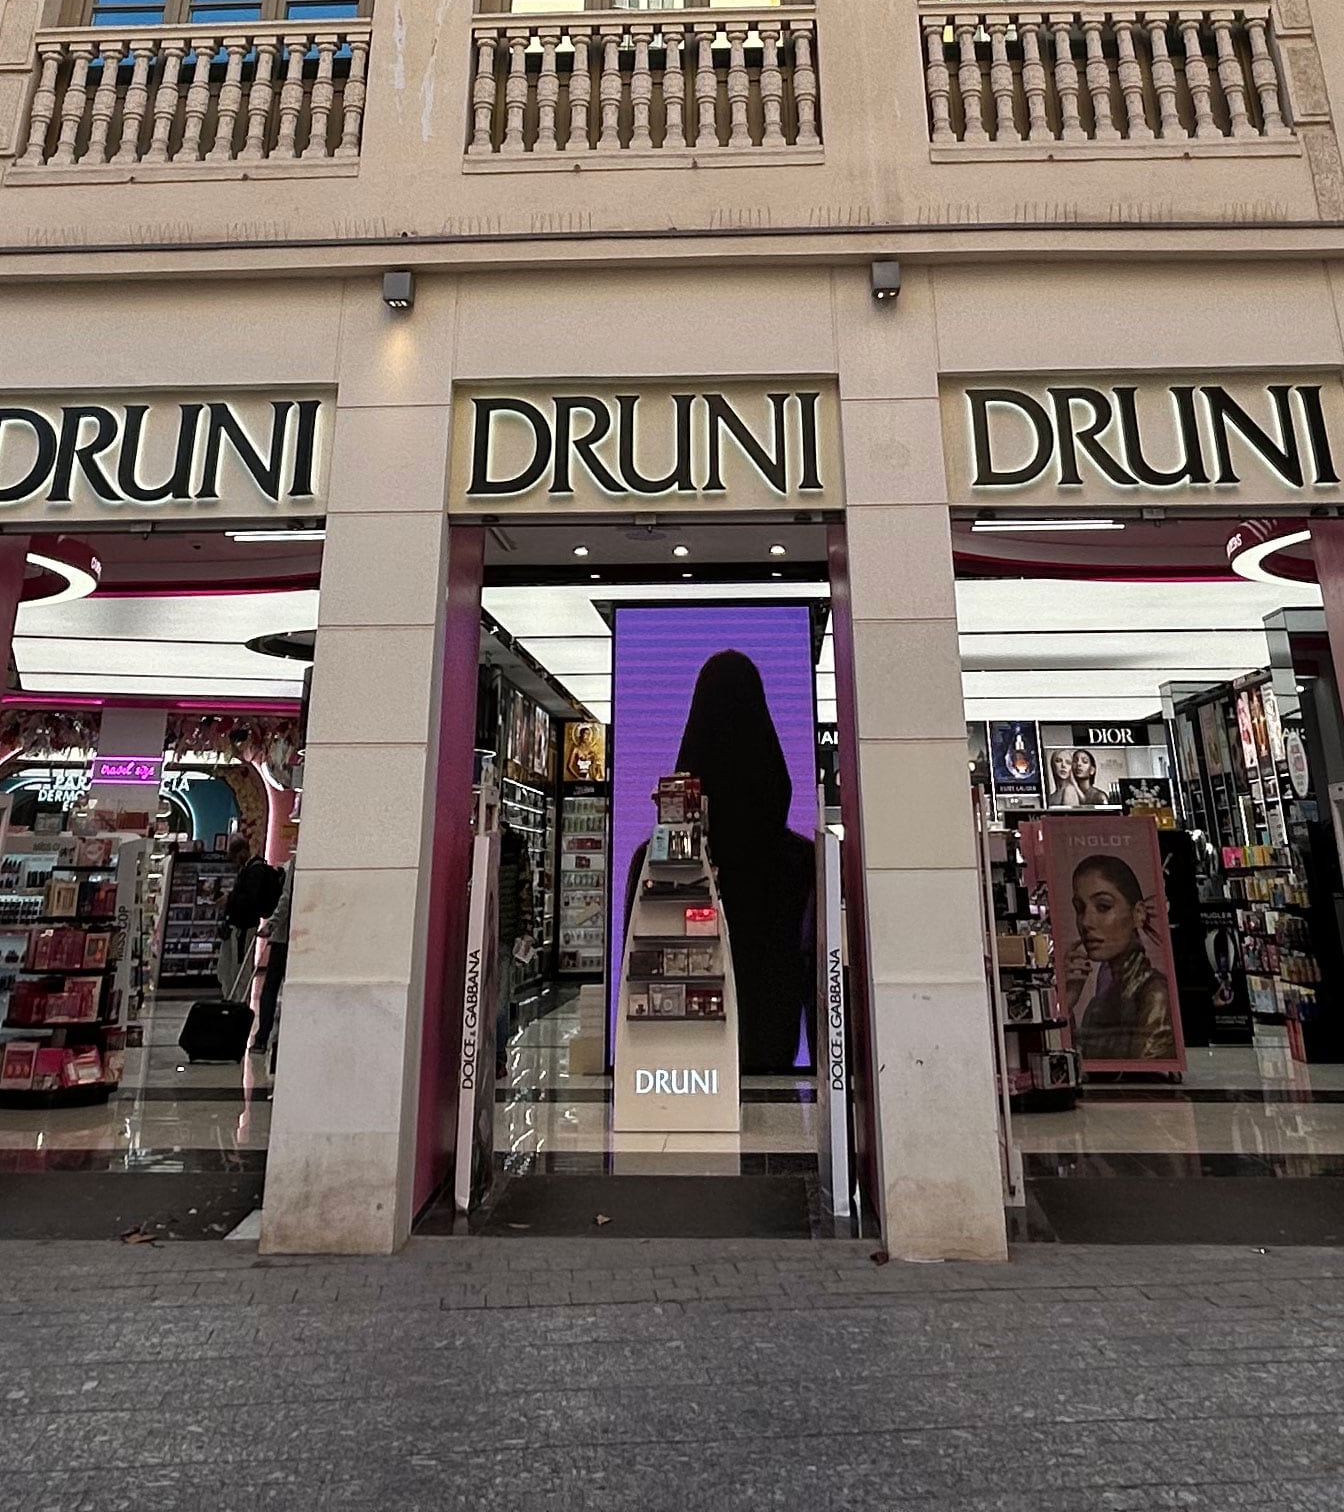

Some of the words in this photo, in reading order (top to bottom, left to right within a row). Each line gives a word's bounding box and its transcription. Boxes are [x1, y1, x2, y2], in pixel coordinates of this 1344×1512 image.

[466, 391, 824, 495] DRUNI
[965, 384, 1342, 488] DRUNI
[1088, 727, 1135, 744] DIOR
[1068, 834, 1131, 848] INGLOT
[465, 948, 481, 1030] GABBANA
[829, 948, 843, 1030] GABBANA
[462, 1038, 477, 1090] DOLCE
[635, 1069, 718, 1095] DRUNI
[831, 1038, 844, 1091] DOLCE
